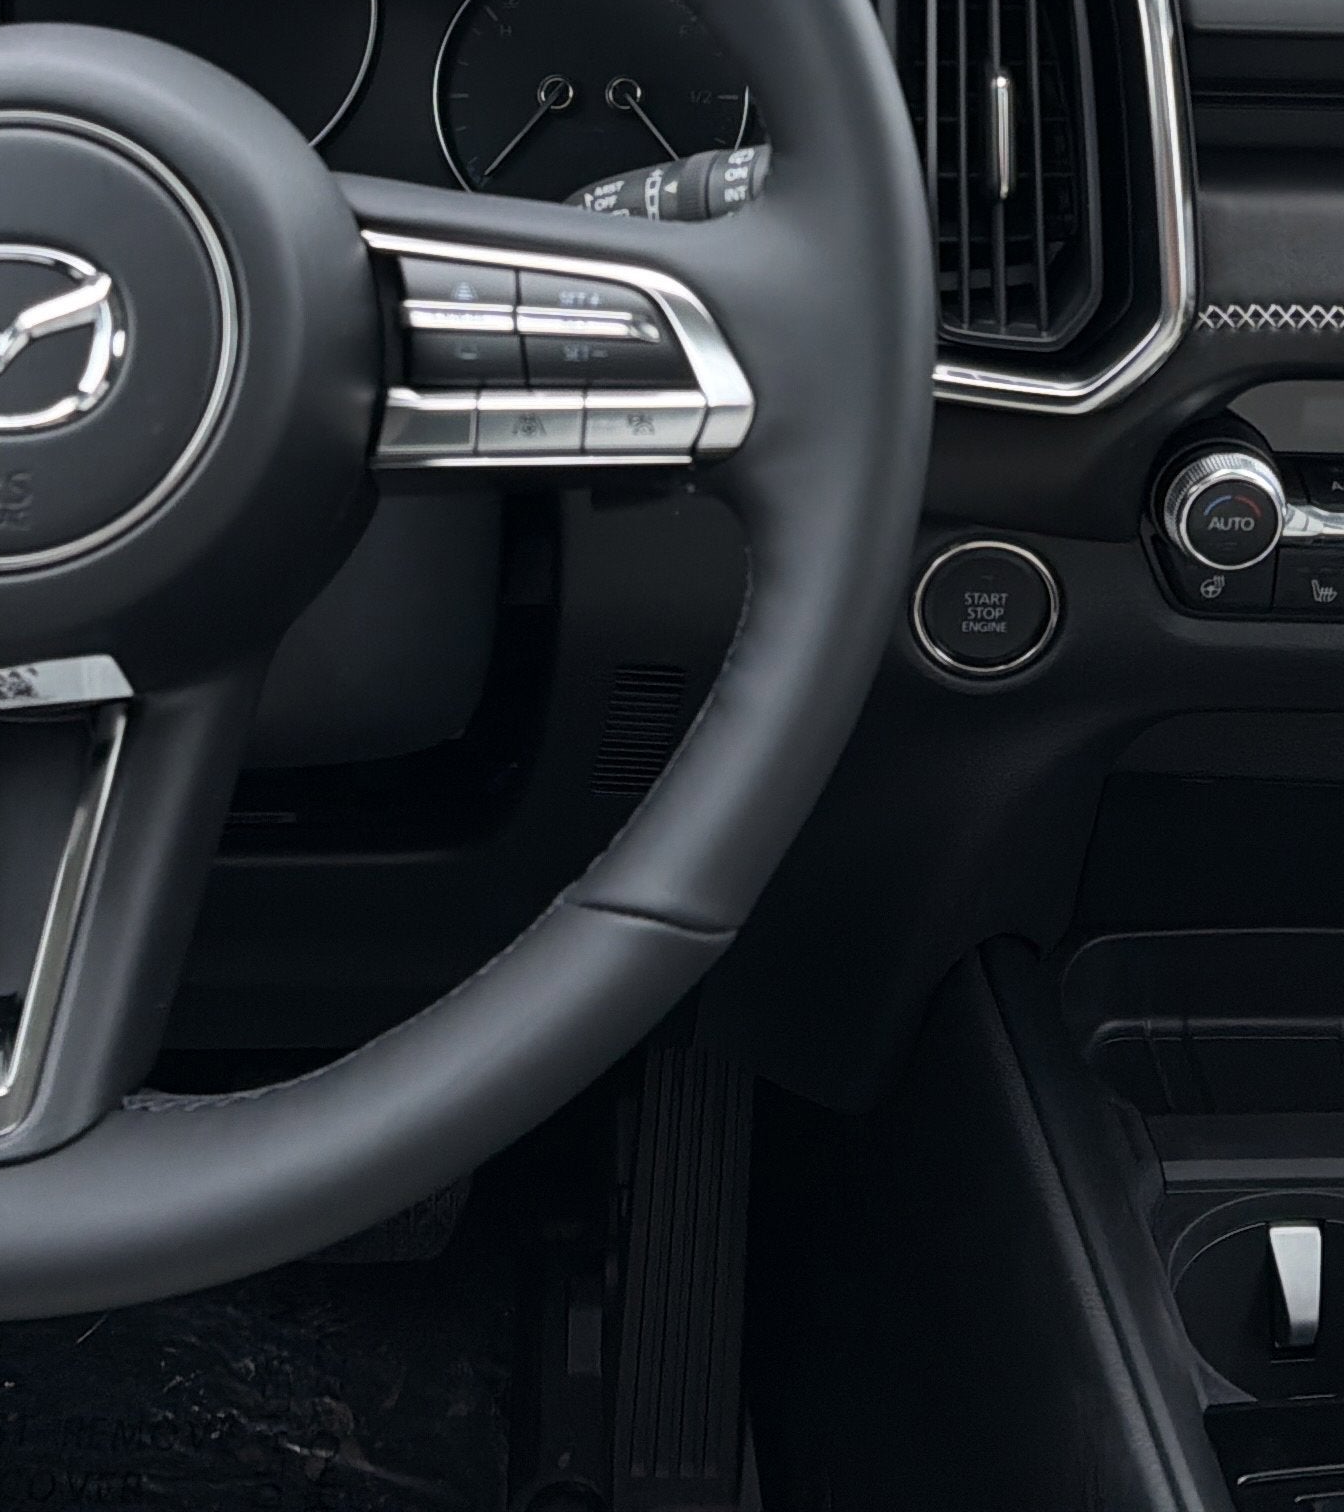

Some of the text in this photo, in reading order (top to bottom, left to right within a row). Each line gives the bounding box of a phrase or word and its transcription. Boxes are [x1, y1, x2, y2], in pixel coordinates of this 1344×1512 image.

[724, 166, 749, 182] ON
[593, 194, 618, 211] OFF
[1207, 516, 1255, 532] AUTO
[964, 592, 1009, 606] START
[967, 607, 1005, 620] STOP
[962, 620, 1008, 633] ENGINE
